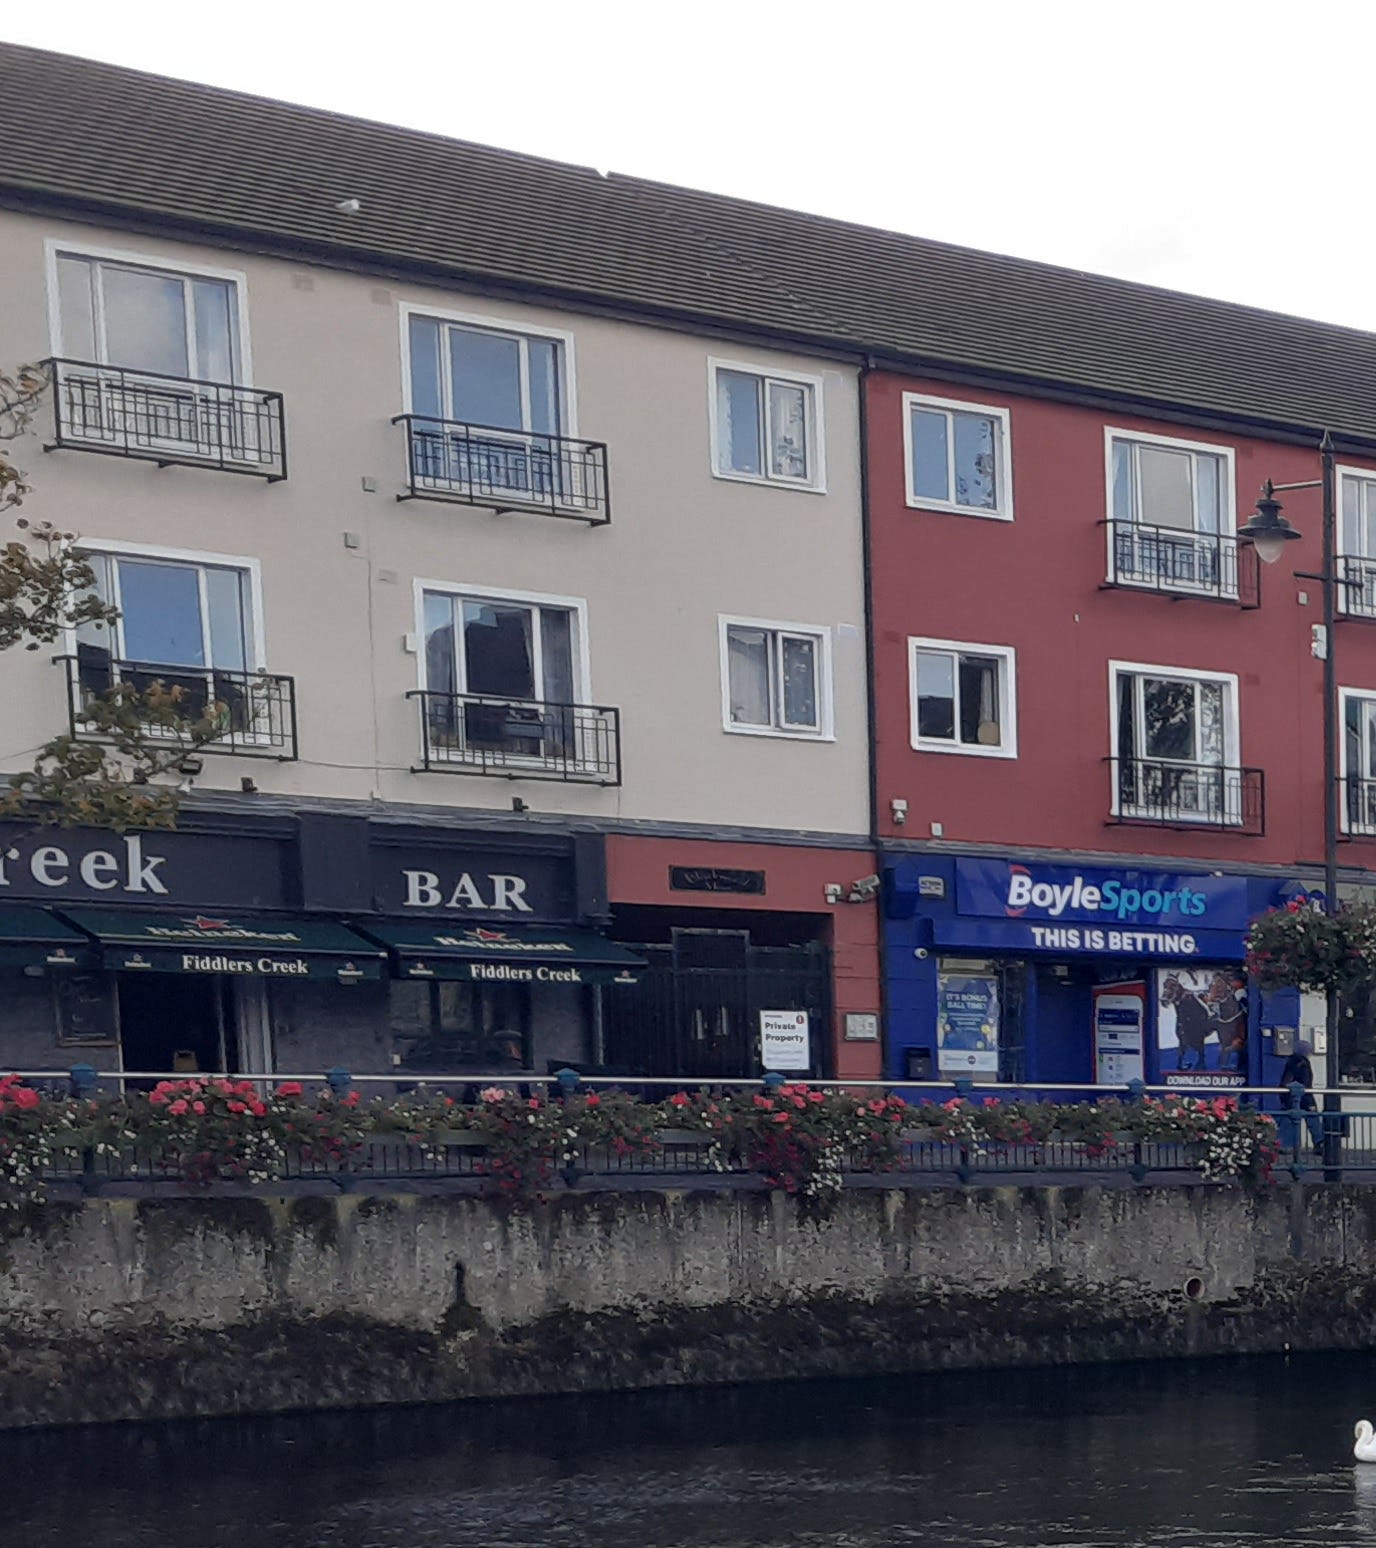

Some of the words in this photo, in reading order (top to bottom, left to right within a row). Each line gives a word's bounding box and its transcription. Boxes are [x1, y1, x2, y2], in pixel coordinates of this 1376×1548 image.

[401, 870, 533, 912] BAR
[1008, 874, 1207, 919] BoyleSports
[1031, 927, 1080, 948] THIS
[1084, 930, 1105, 949] IS
[182, 955, 253, 973] Fiddlers
[257, 957, 309, 974] Creek
[470, 964, 533, 980] Fiddlers
[536, 967, 582, 982] Creek
[764, 1022, 796, 1030] Private
[765, 1033, 804, 1043] Property
[1166, 1075, 1211, 1086] DOWNLOAD
[1212, 1076, 1229, 1087] OUR
[1230, 1076, 1246, 1087] APP
